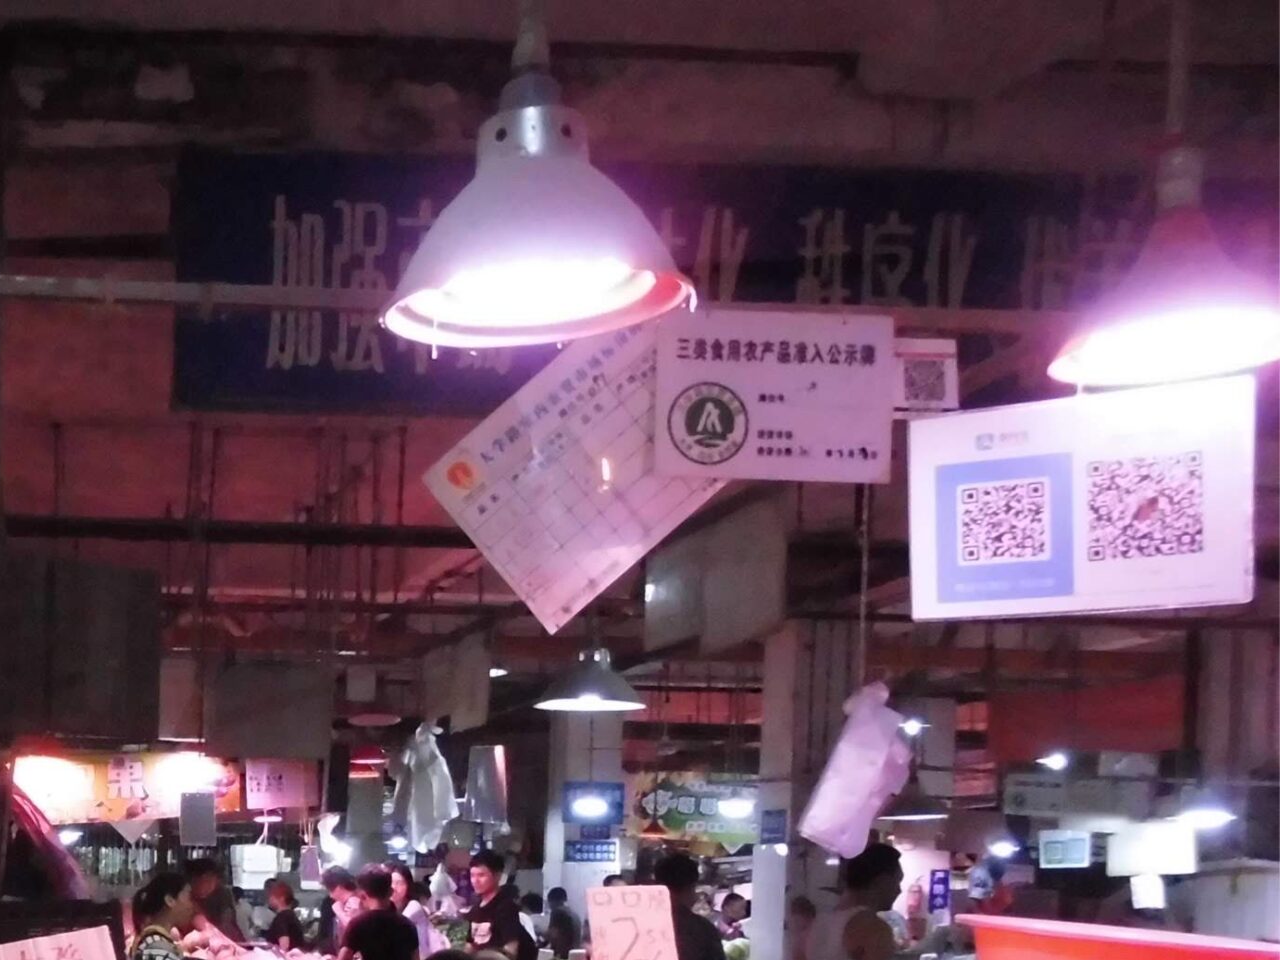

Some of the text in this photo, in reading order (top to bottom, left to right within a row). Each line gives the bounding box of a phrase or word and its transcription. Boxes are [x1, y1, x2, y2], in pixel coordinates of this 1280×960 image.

[676, 338, 876, 366] 三类食用农产品准入公示牌
